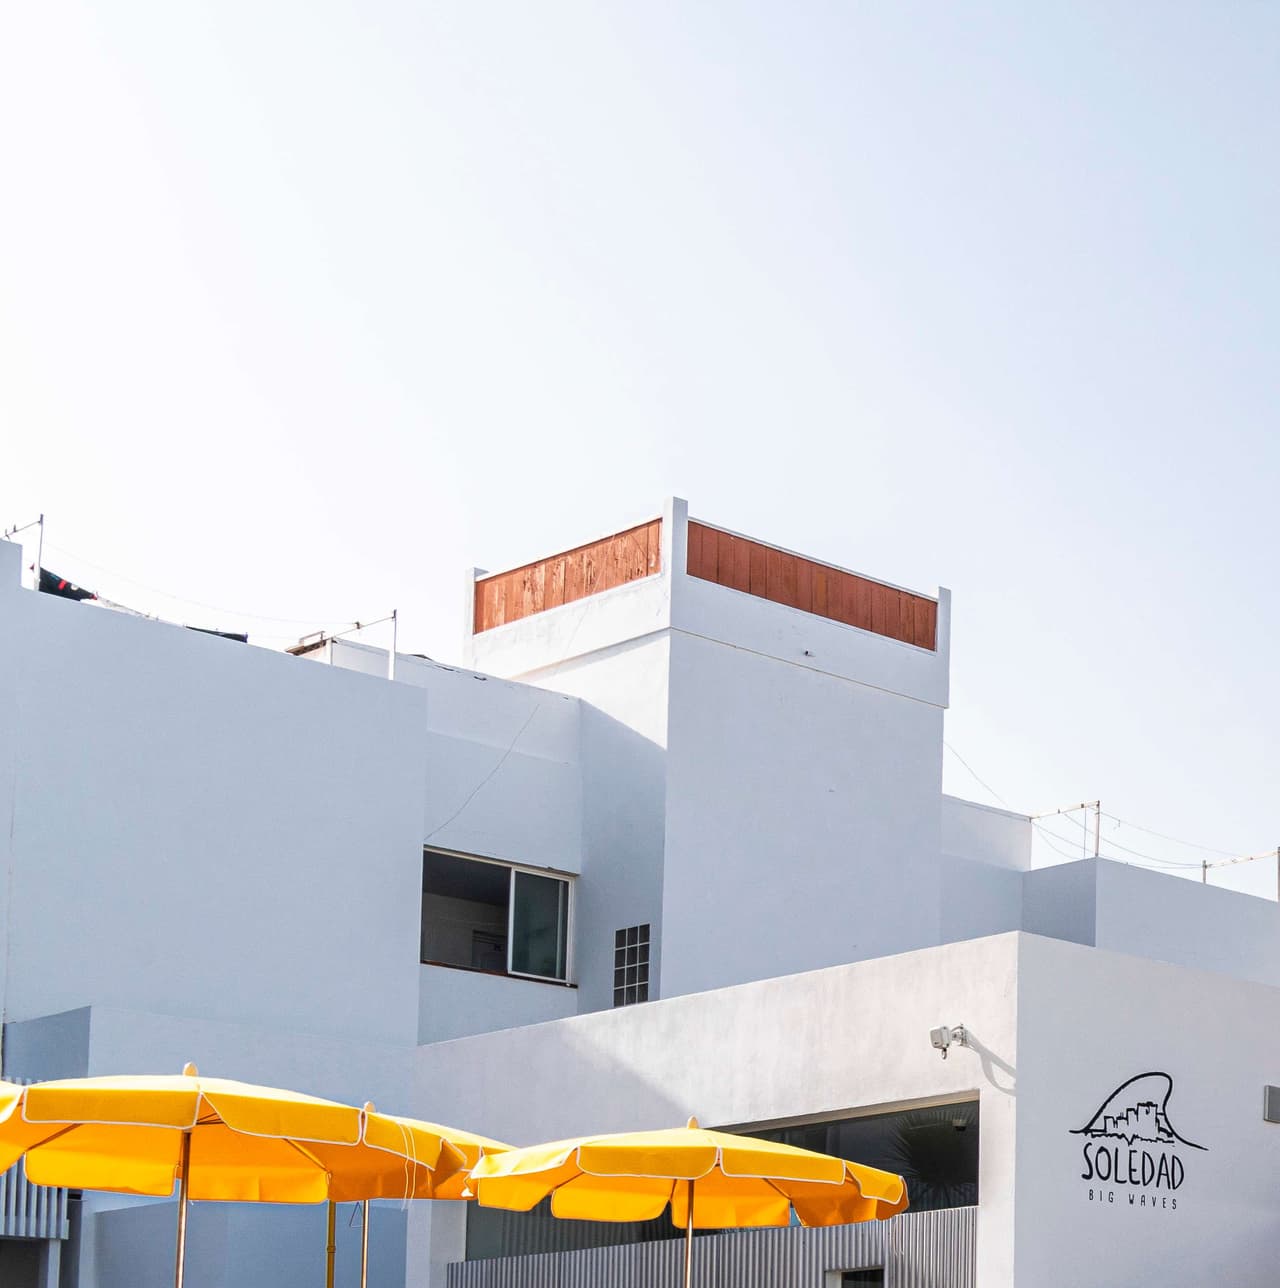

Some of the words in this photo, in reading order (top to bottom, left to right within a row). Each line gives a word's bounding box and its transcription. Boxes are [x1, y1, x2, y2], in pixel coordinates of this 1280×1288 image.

[1081, 1142, 1185, 1190] SOLEDAD
[1088, 1189, 1114, 1203] BIG
[1128, 1194, 1177, 1210] WAVES
